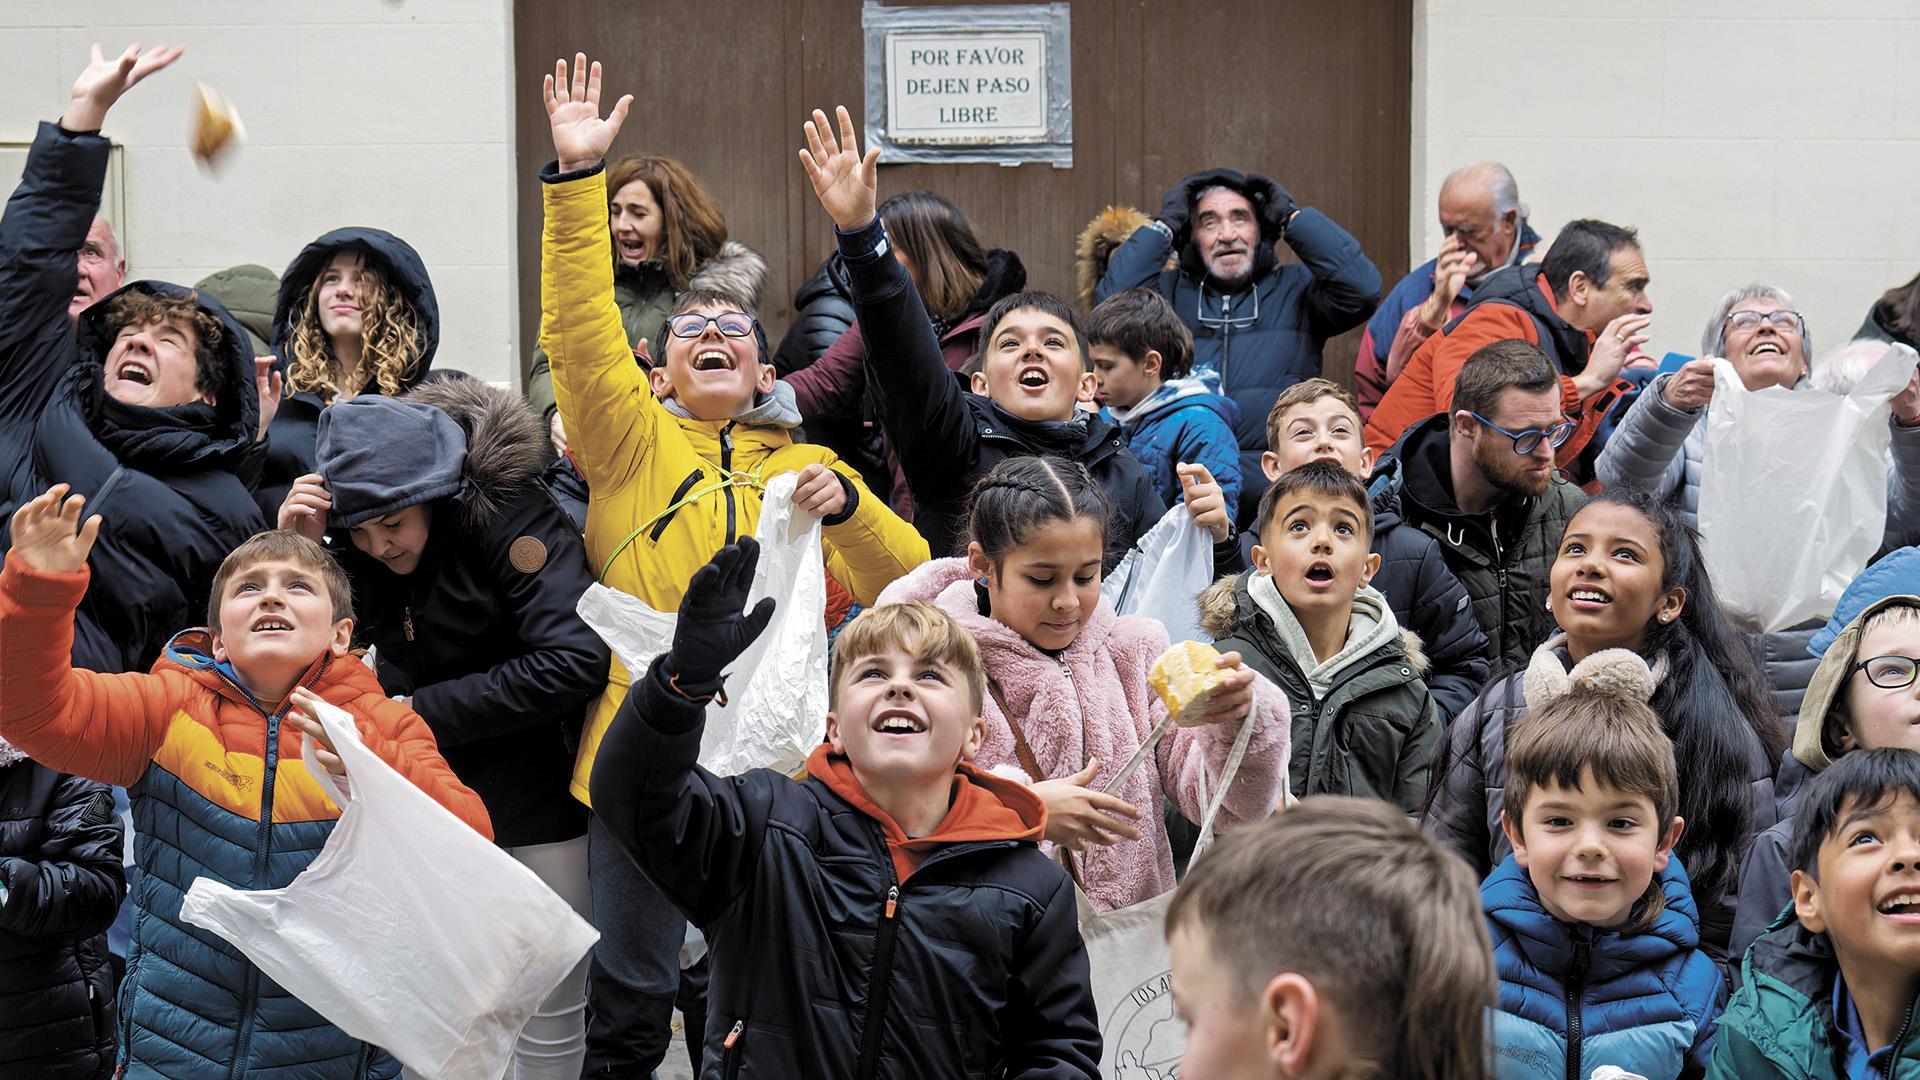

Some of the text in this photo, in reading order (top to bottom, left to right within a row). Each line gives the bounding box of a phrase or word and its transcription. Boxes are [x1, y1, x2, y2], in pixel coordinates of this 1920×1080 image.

[911, 47, 1025, 66] POR FAVOR
[906, 77, 1030, 95] DEJEN PASO
[939, 106, 999, 124] LIBRE
[1130, 983, 1157, 1008] LOS
